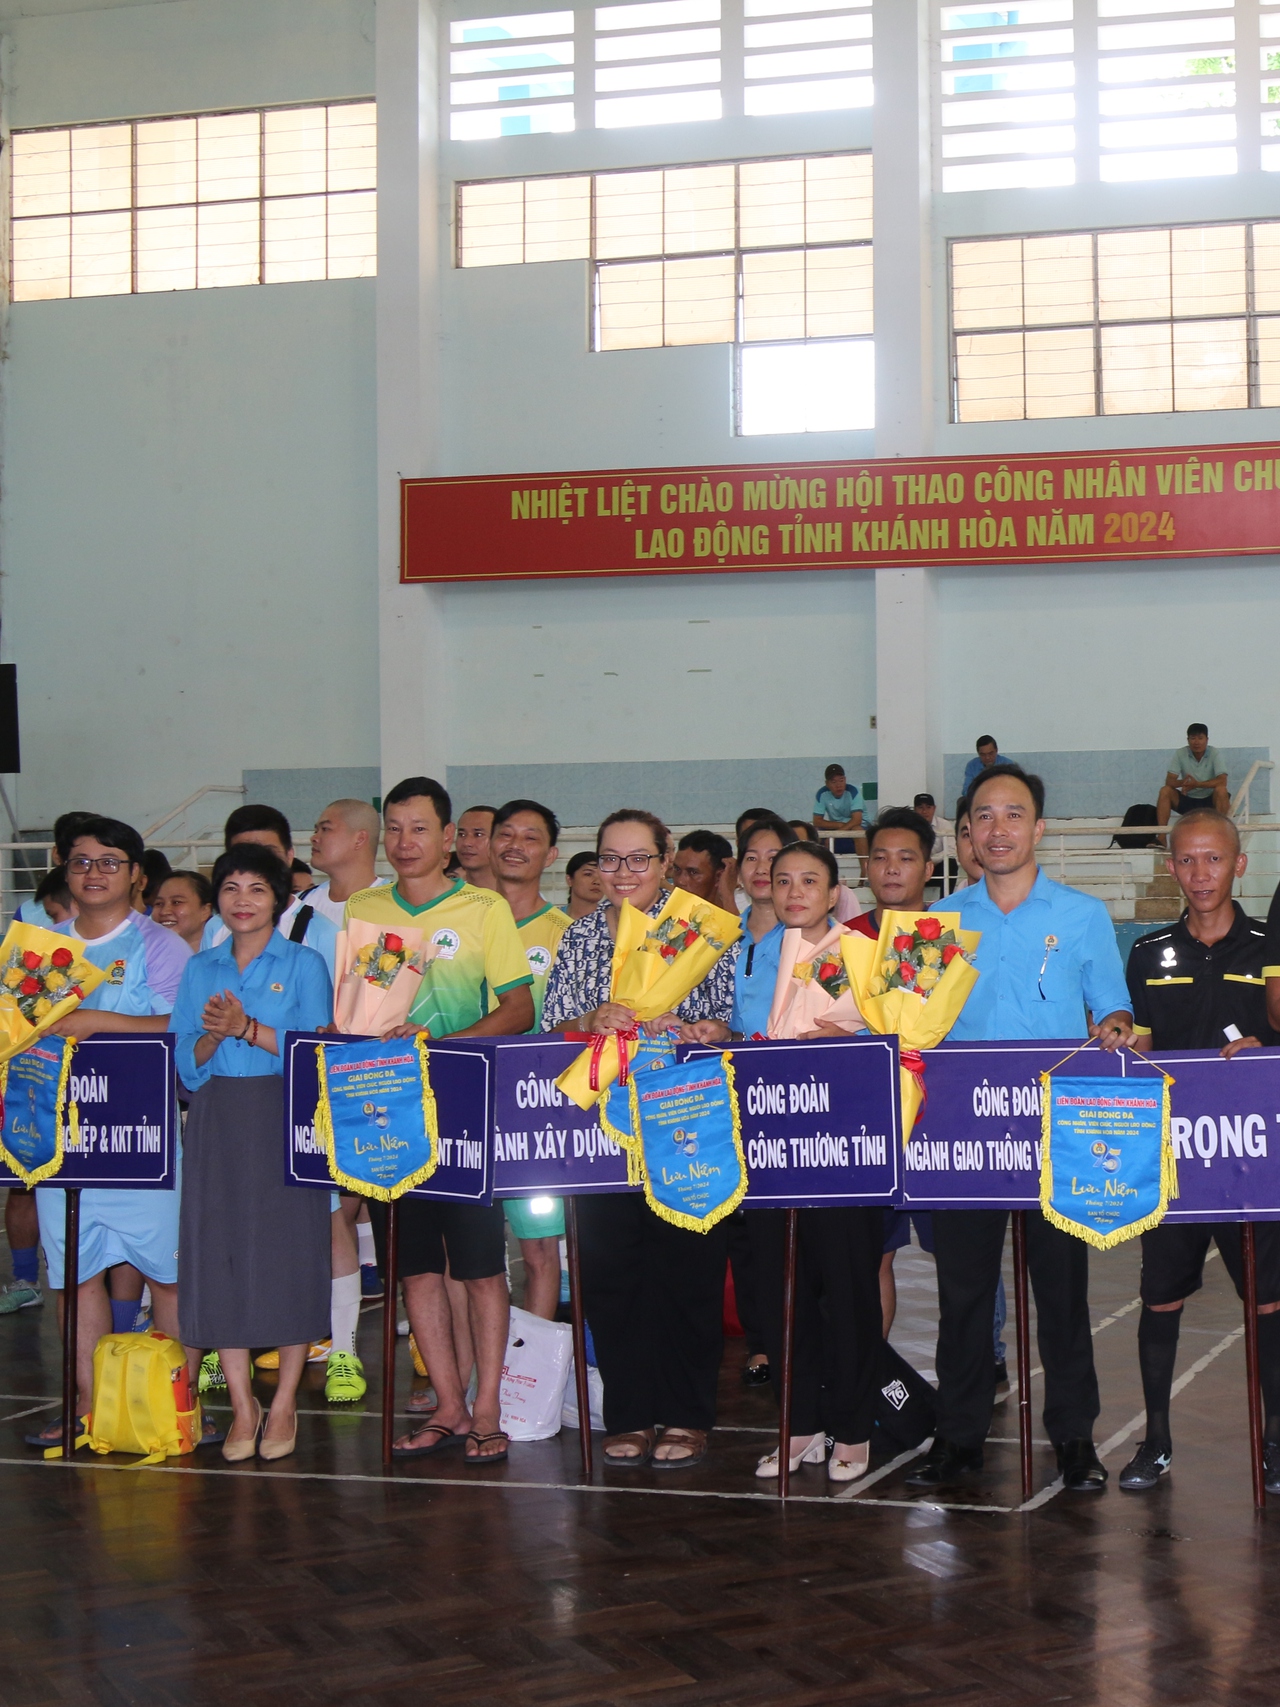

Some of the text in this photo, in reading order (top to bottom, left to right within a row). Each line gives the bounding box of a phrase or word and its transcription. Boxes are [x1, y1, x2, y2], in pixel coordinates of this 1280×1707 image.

[511, 482, 588, 524] NHIỆT
[597, 479, 649, 523] LIỆT
[660, 476, 733, 515] CHÀO
[743, 473, 826, 512] MỪNG
[837, 469, 883, 513] HỘI
[893, 472, 964, 505] THAO
[975, 464, 1053, 502] CÔNG
[1064, 460, 1146, 500] NHÂN
[1155, 456, 1223, 495] VIÊN
[635, 508, 1176, 564] LAO ĐỘNG TỈNH KHÁNH HÒA NĂM 2024
[70, 1068, 108, 1103] ĐOÀN
[516, 1071, 562, 1109] CÔNG
[747, 1076, 786, 1115] CÔNG
[789, 1074, 830, 1114] ĐOÀN
[973, 1078, 1009, 1117] CÔNG
[100, 1125, 109, 1153] &
[111, 1125, 133, 1153] KKT
[136, 1115, 161, 1153] TỈNH
[295, 1118, 328, 1155] NGÀ
[456, 1129, 482, 1170] TỈNH
[533, 1122, 567, 1160] XÂY
[748, 1124, 887, 1169] CÔNG THƯƠNG TỈNH
[905, 1133, 949, 1171] NGÀNH
[953, 1140, 984, 1171] GIAO
[986, 1132, 1032, 1171] THÔNG
[1170, 1113, 1267, 1168] RỌNG
